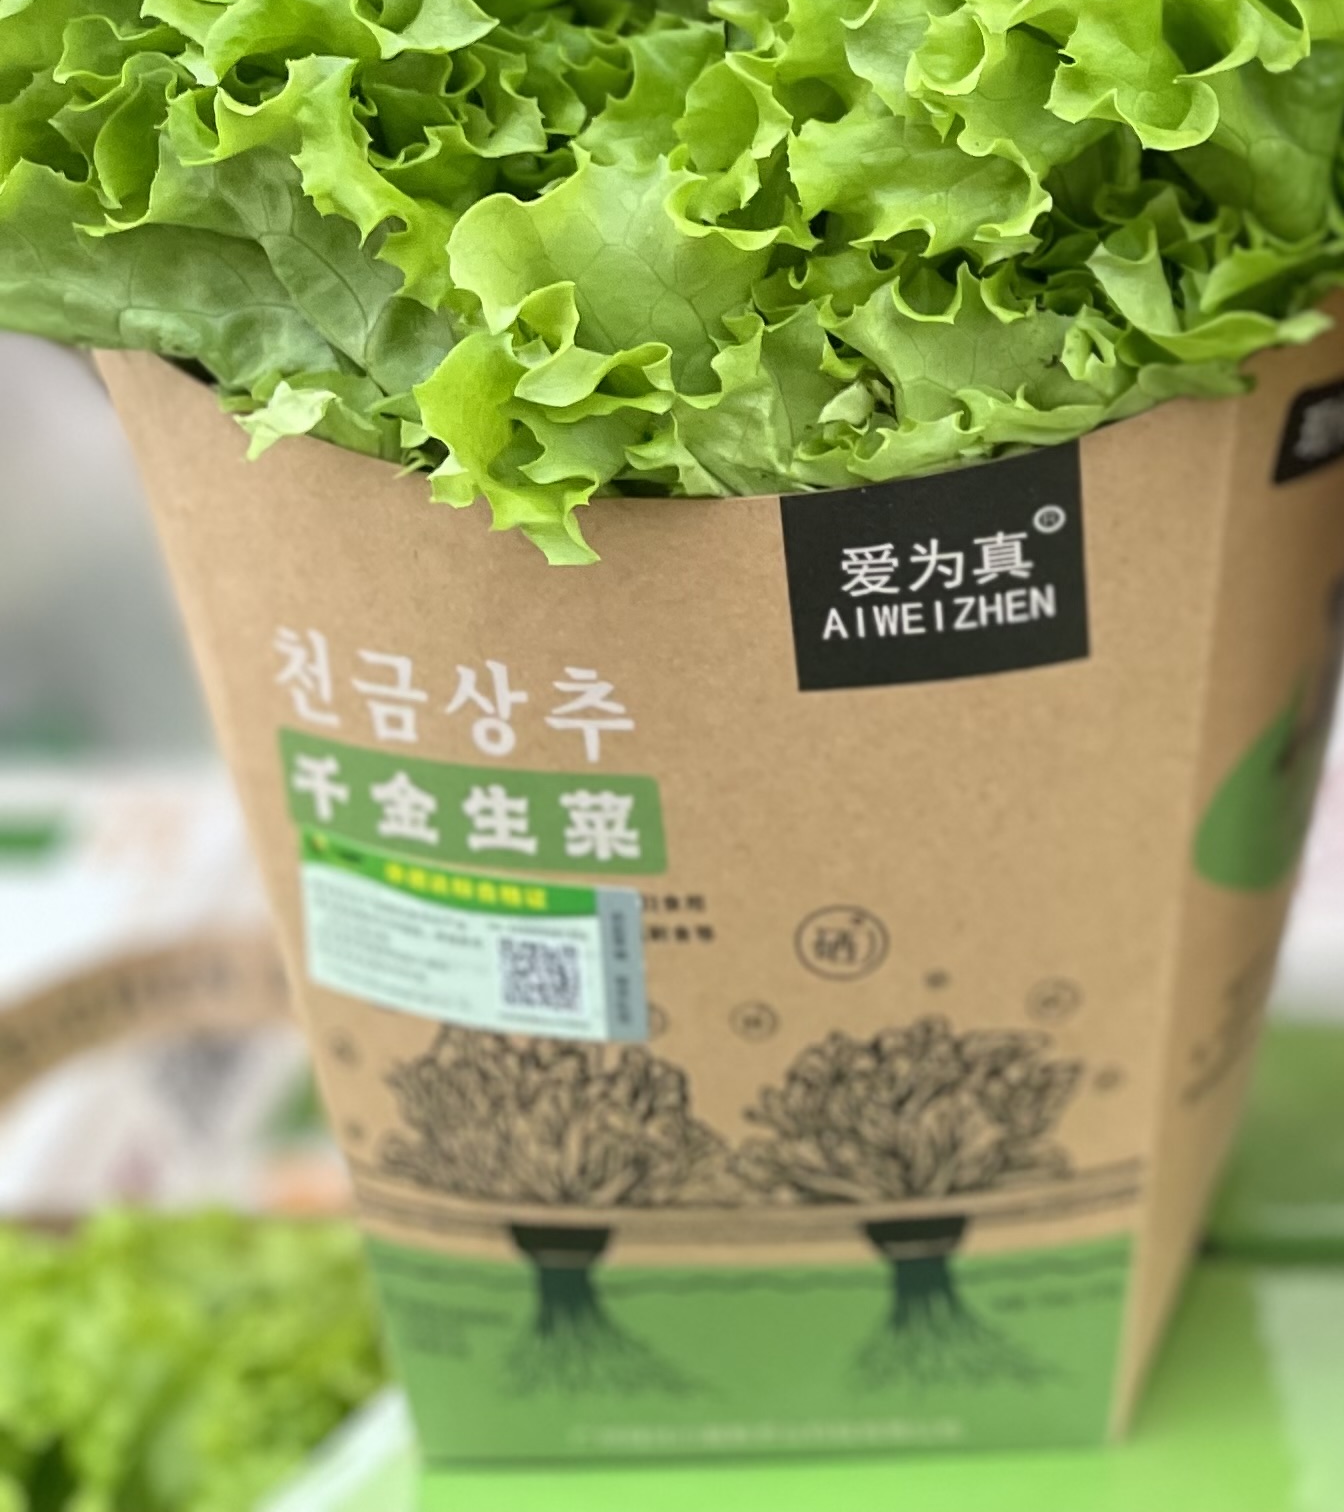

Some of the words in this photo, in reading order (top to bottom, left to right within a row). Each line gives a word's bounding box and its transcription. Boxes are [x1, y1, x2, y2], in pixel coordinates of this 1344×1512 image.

[841, 531, 1034, 598] 爱为真
[821, 584, 1056, 639] AIWEIZHEN
[272, 626, 636, 762] 천금상추
[291, 754, 641, 860] 千金生菜
